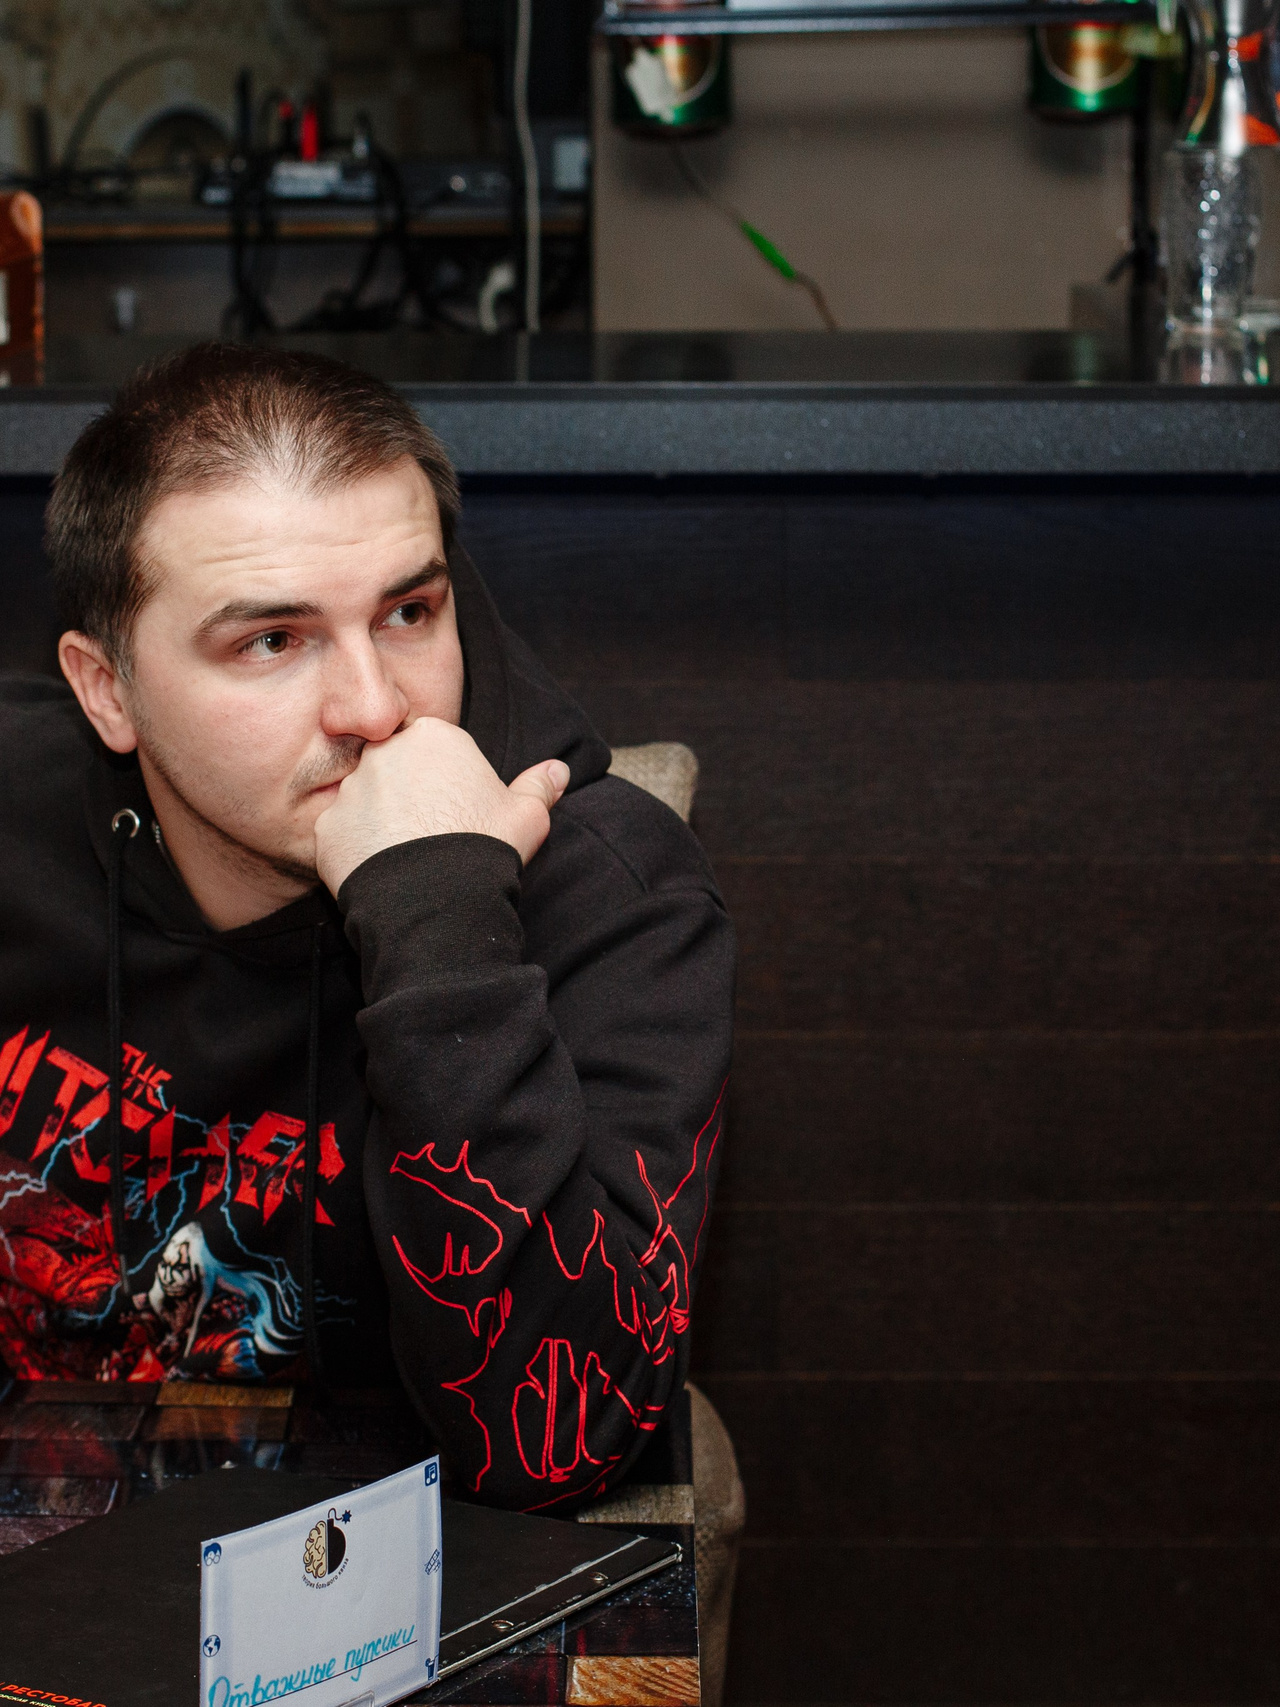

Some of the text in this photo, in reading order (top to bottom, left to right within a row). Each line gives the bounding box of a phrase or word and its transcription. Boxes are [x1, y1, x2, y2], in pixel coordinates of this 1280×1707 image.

[122, 1042, 172, 1104] THE
[208, 1624, 416, 1707] Отважные пупсики
